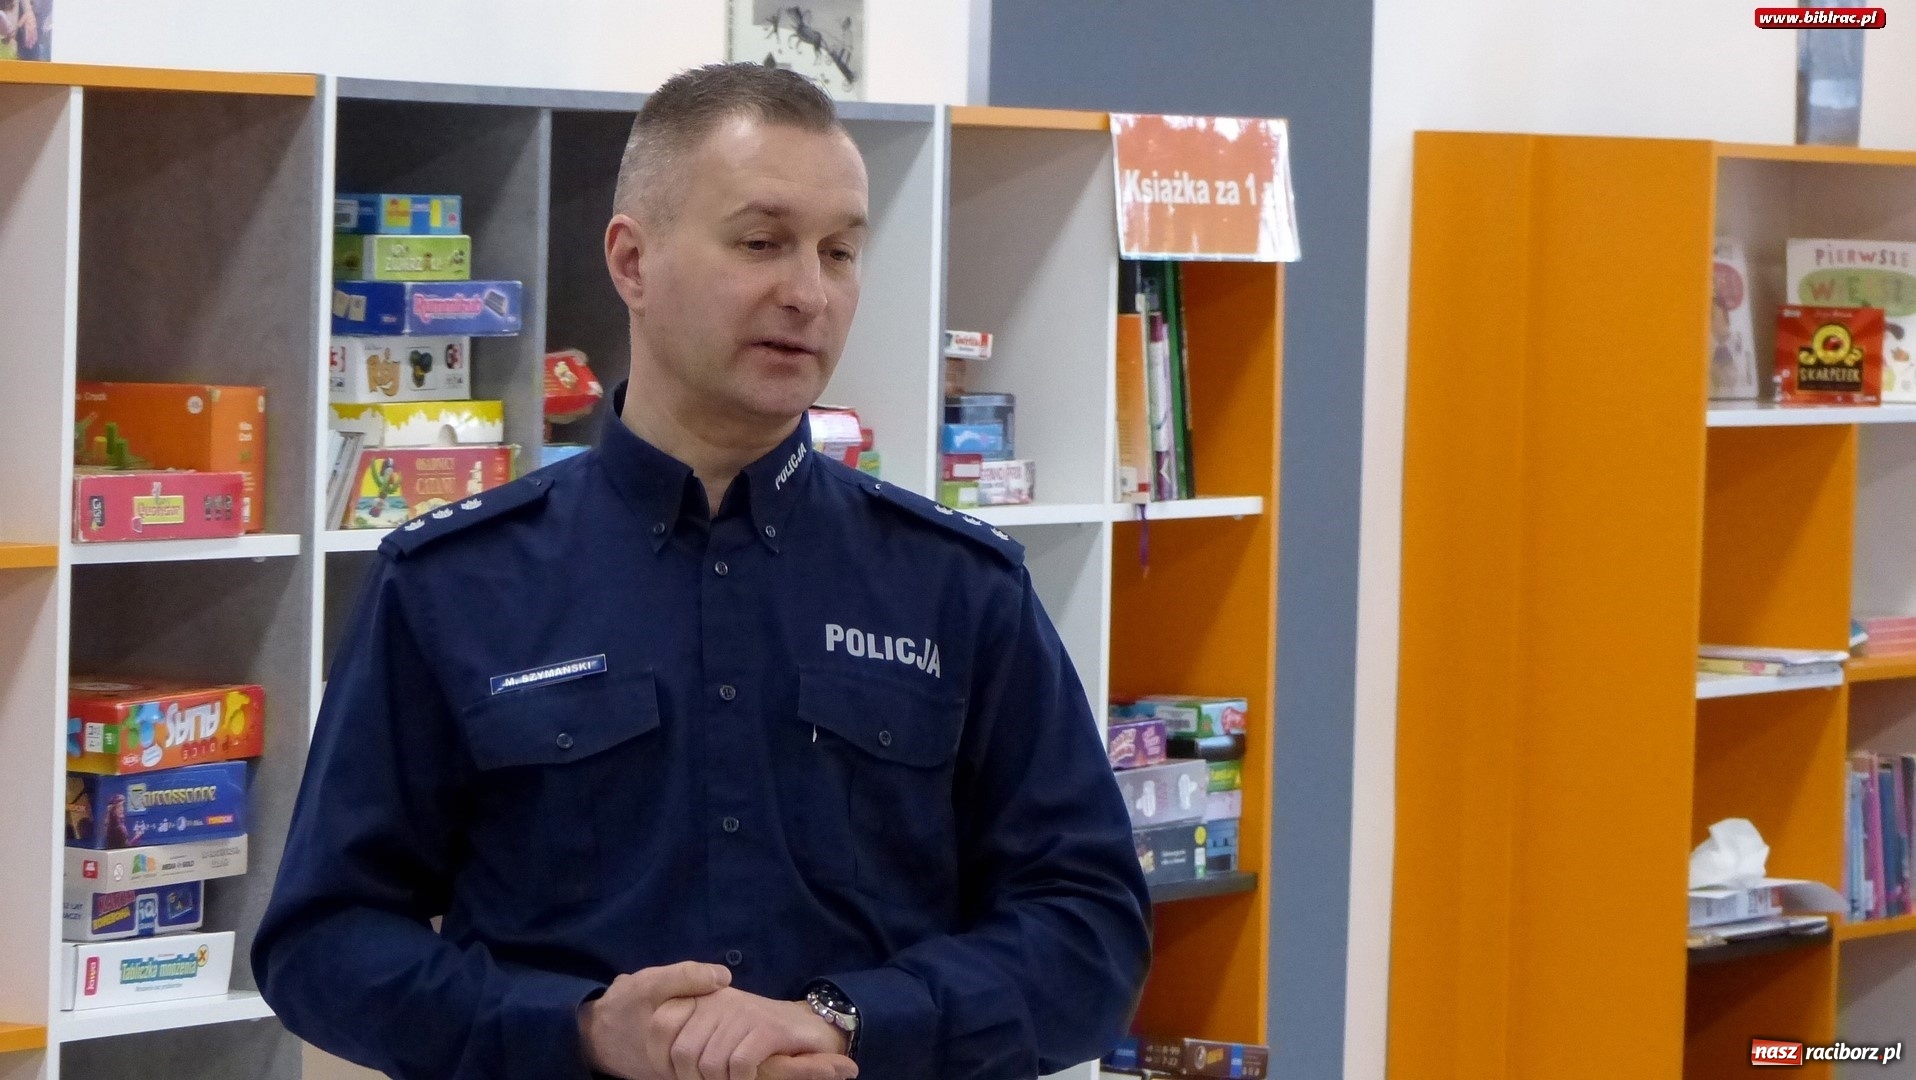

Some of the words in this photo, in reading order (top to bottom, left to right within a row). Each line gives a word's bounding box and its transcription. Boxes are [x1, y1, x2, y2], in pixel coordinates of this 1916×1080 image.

[1124, 168, 1210, 216] Książka
[1214, 180, 1241, 206] za
[1245, 172, 1257, 206] 1
[775, 442, 807, 491] POLICJA
[825, 623, 941, 679] POLICJA
[504, 676, 519, 687] M.
